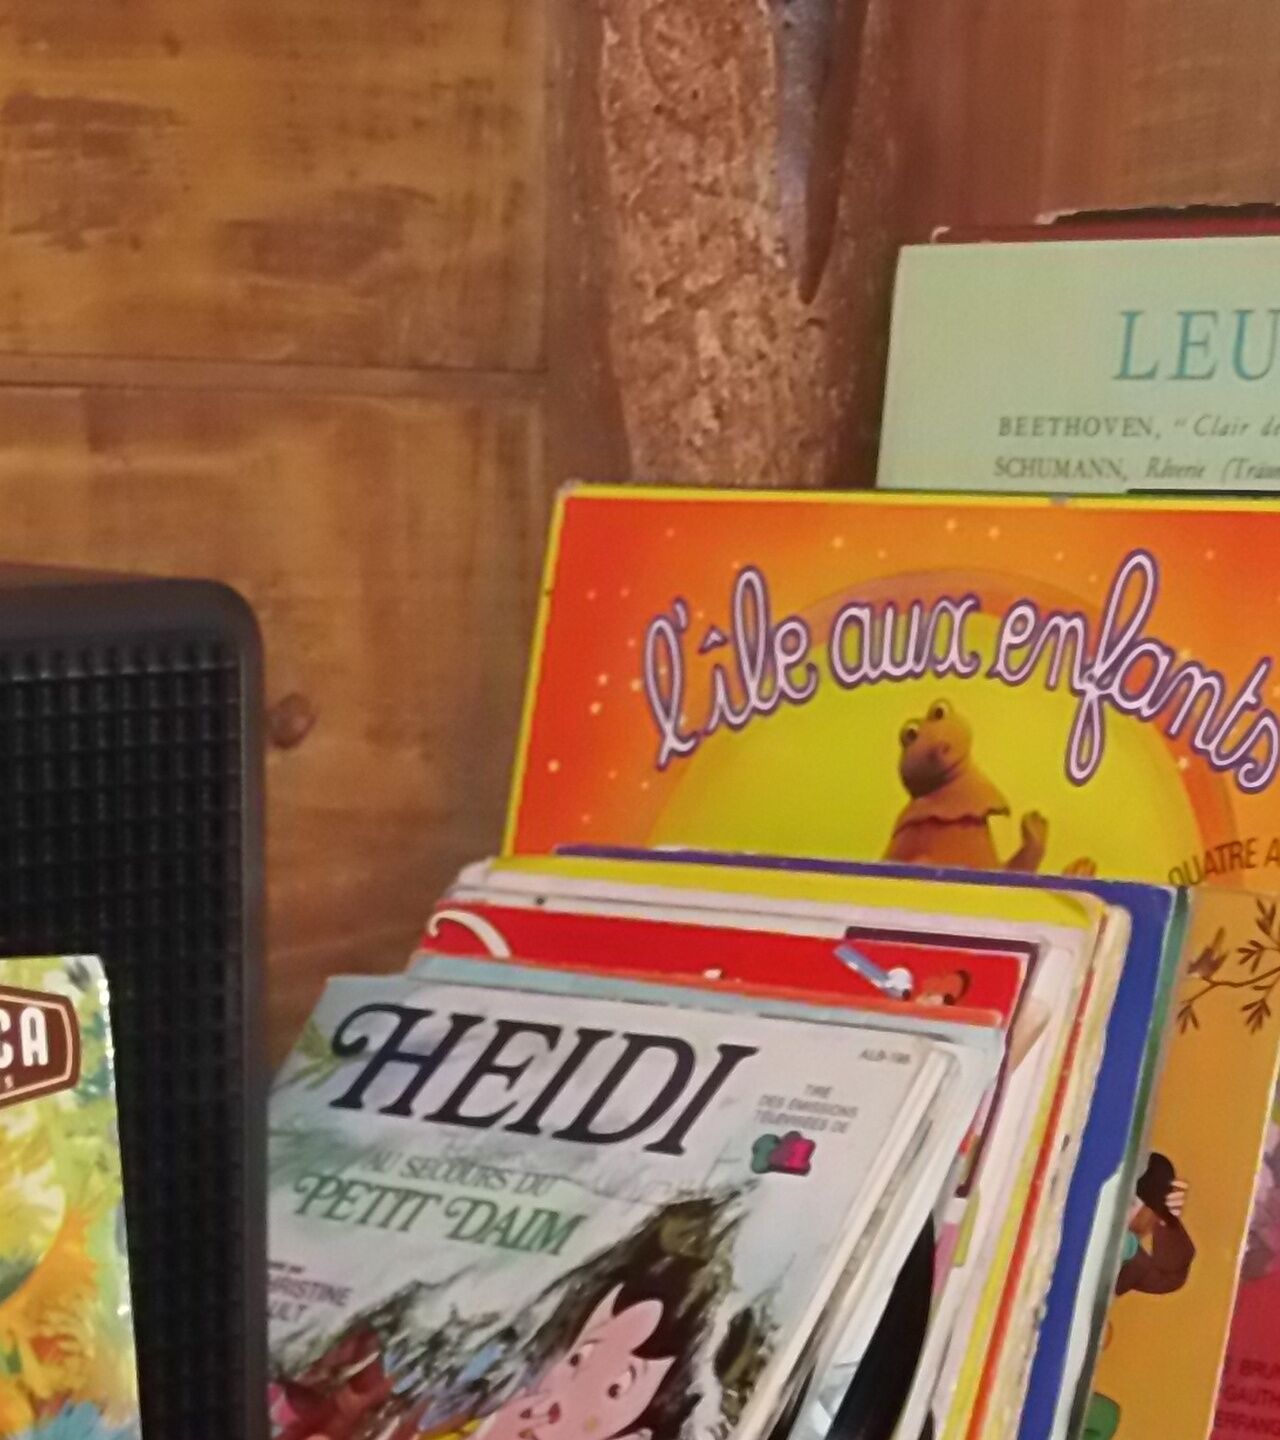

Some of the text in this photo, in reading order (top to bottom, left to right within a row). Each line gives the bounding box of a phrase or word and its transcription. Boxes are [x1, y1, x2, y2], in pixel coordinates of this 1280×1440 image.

[998, 416, 1161, 440] BEETHOVEN,
[993, 457, 1128, 482] SCHUMANN,
[829, 593, 985, 687] aux
[1167, 837, 1260, 887] QUATRE
[329, 1002, 760, 1156] HEIDI
[365, 1149, 559, 1197] AU SECOURS DU
[293, 1172, 590, 1256] PETIT DAIM
